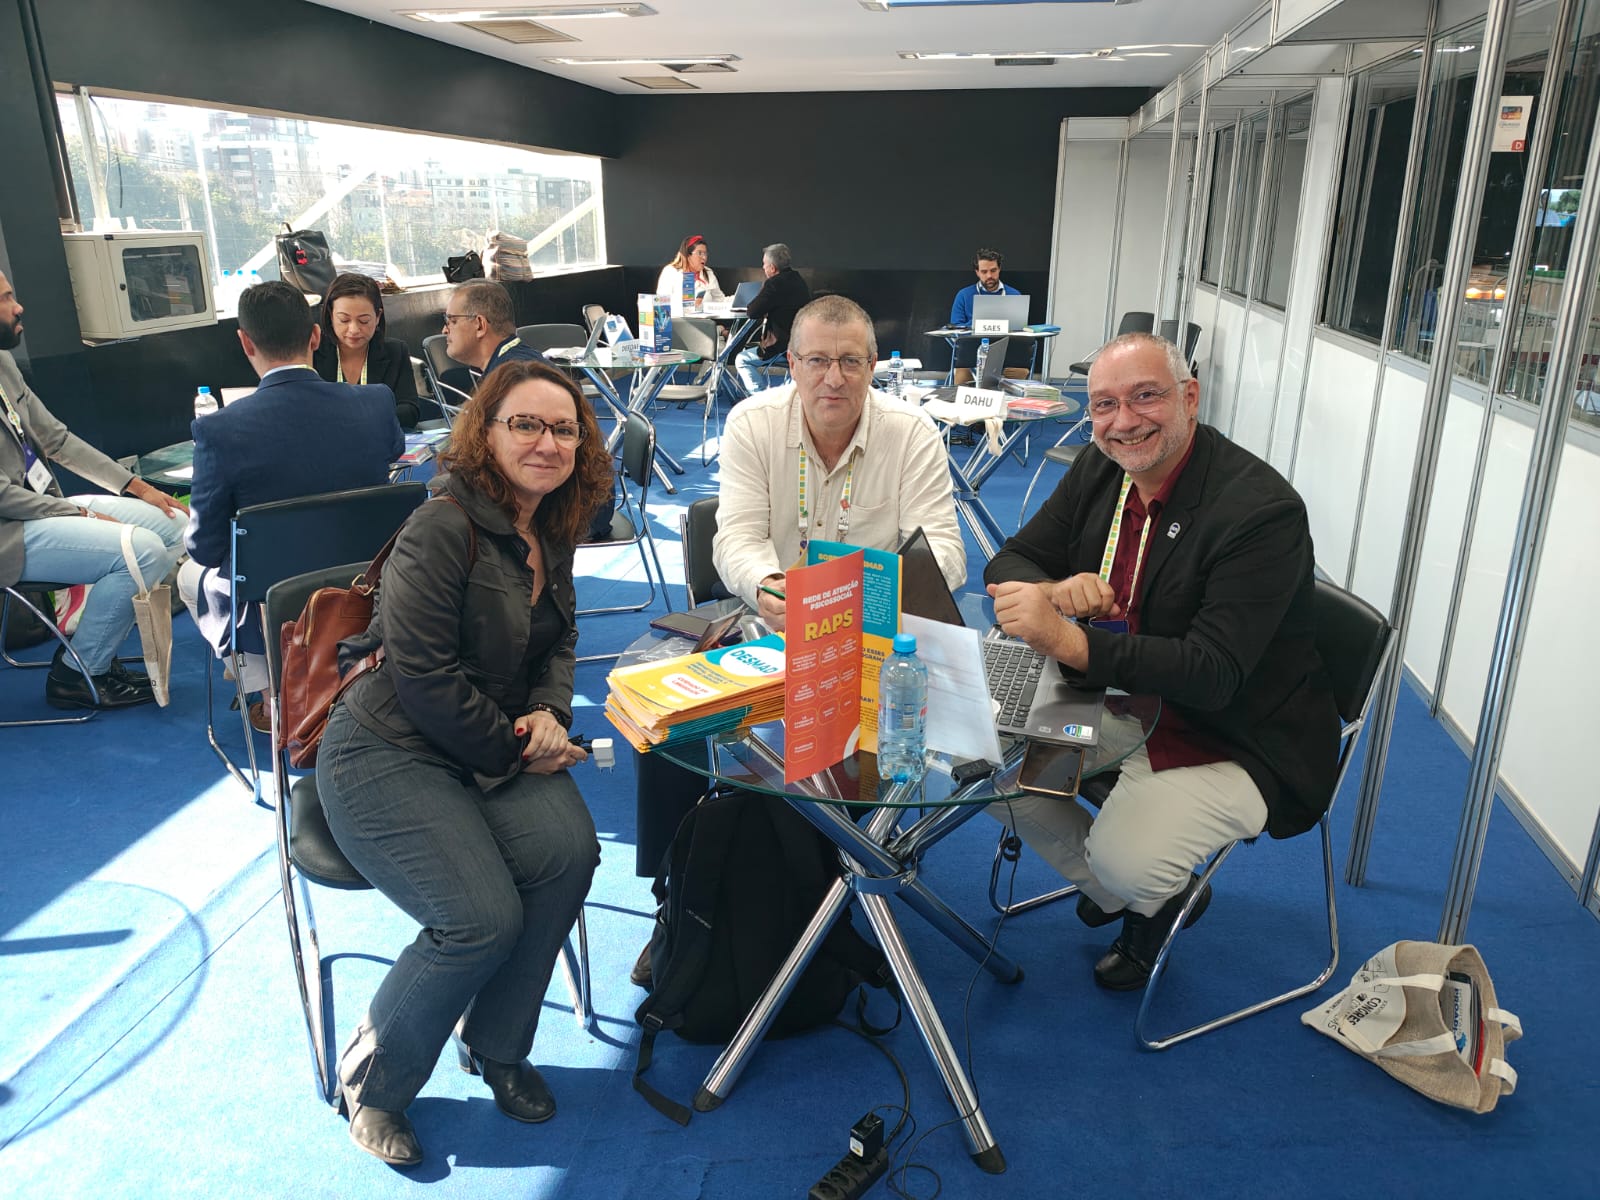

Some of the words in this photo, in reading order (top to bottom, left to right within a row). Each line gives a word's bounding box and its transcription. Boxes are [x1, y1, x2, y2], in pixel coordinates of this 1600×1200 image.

[982, 324, 1001, 332] SAES
[963, 394, 993, 407] DAHU
[822, 590, 832, 599] DE
[804, 608, 854, 642] RAPS
[730, 649, 779, 674] DESMAD
